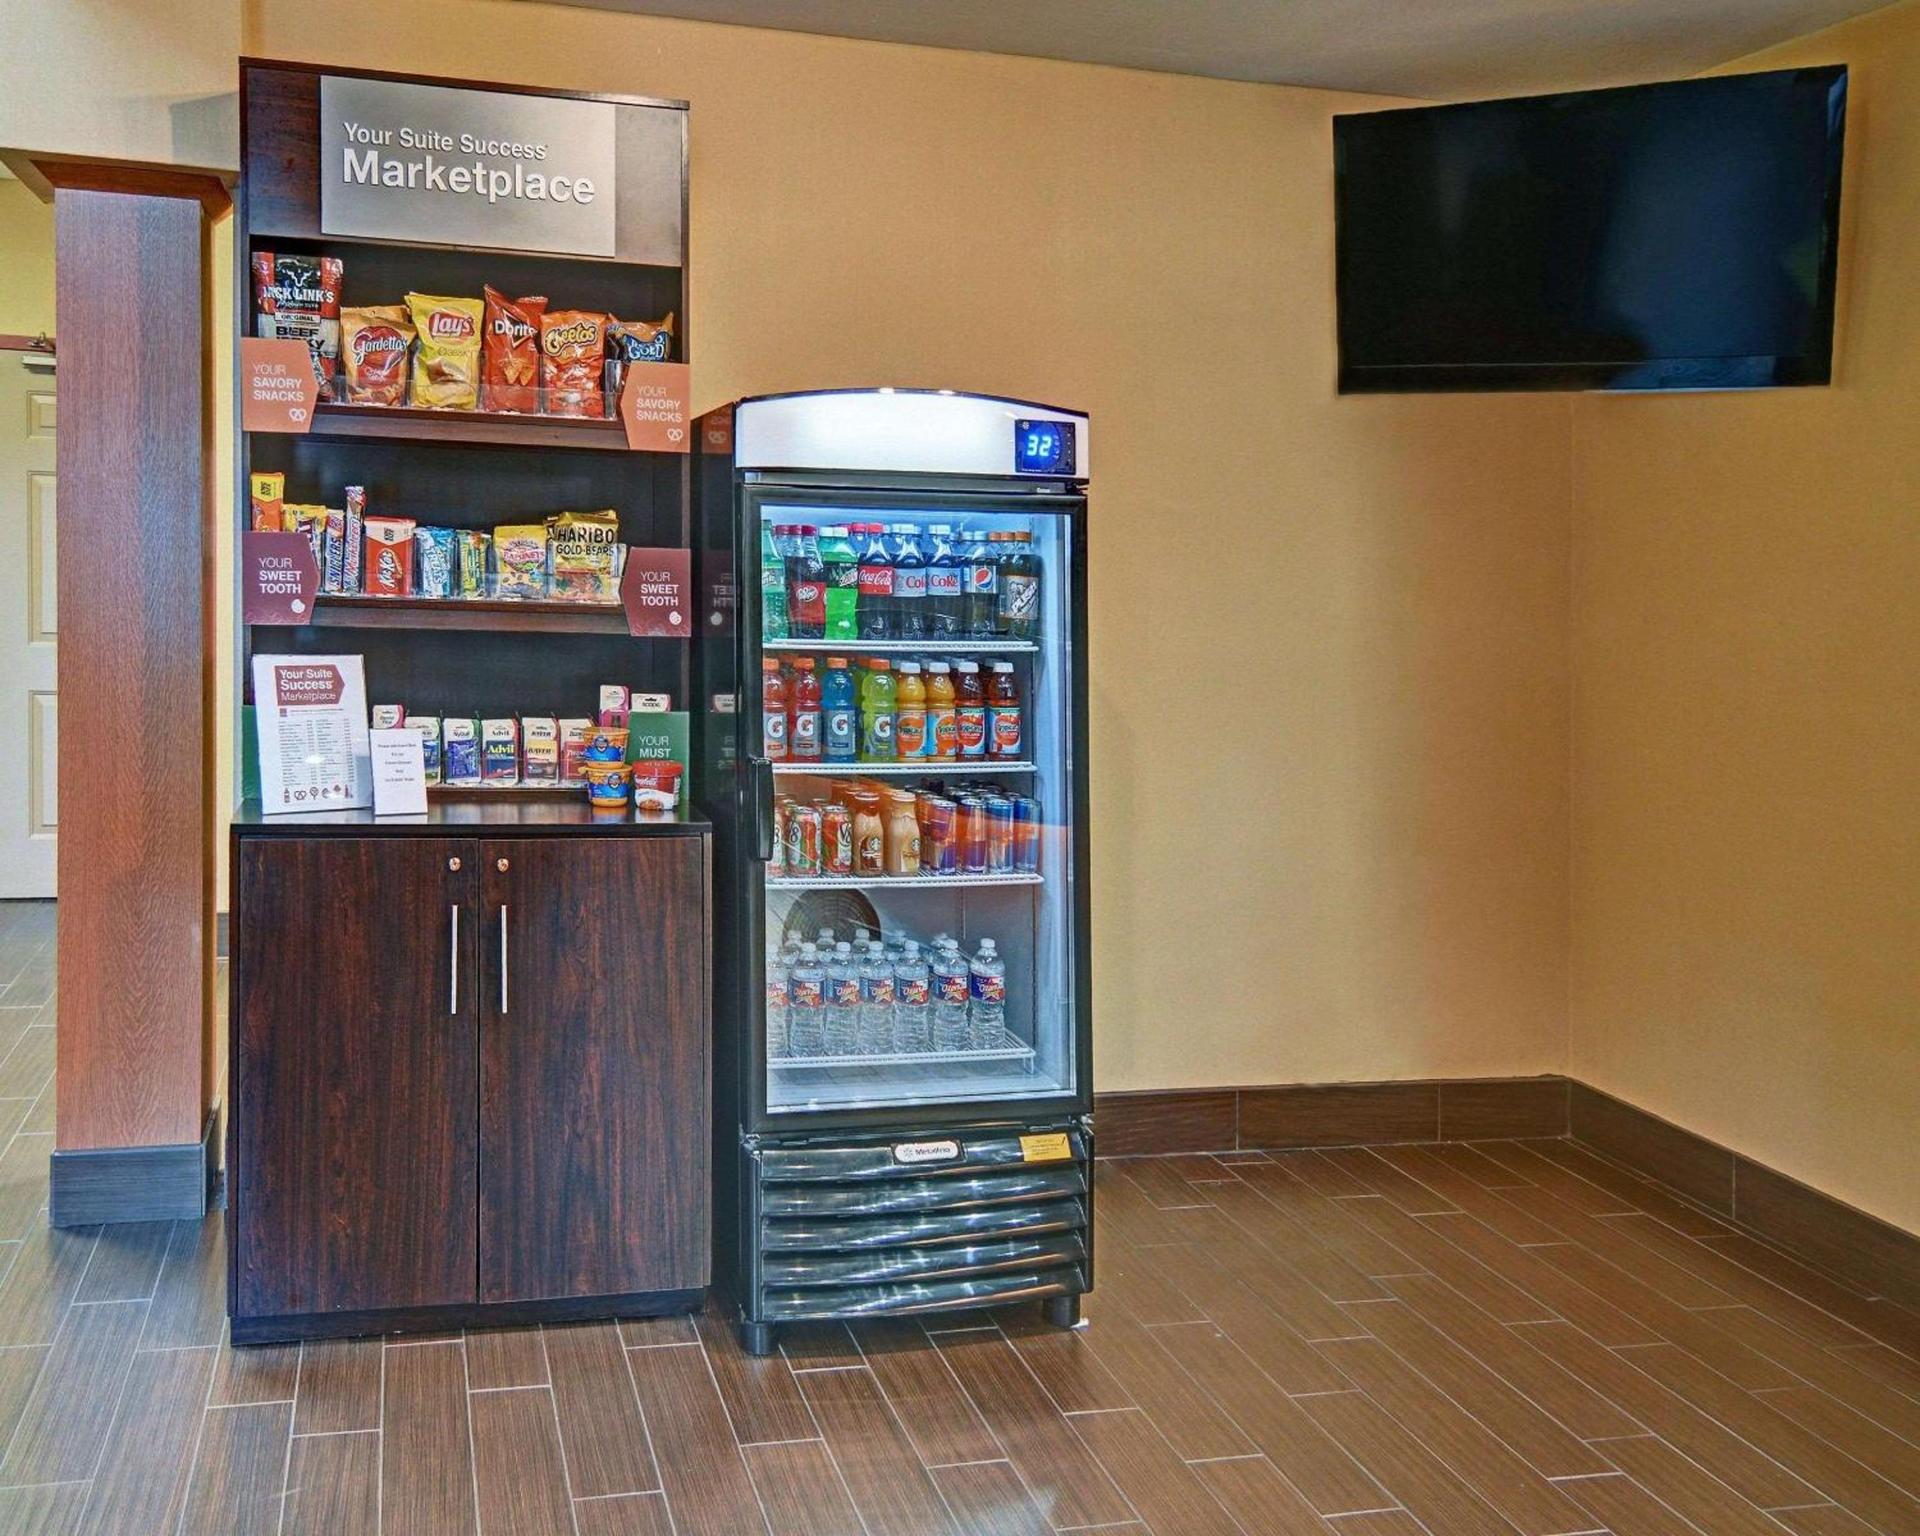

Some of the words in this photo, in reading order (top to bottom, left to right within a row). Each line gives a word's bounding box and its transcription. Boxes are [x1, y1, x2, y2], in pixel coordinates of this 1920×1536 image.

[343, 122, 393, 146] Your
[399, 128, 453, 152] Suite
[460, 134, 548, 161] Success
[343, 147, 596, 204] Marketplace
[292, 286, 334, 304] LINK'S
[276, 326, 319, 337] BEEF
[545, 322, 597, 356] Cheetos
[253, 364, 287, 375] YOUR
[253, 377, 302, 388] SAVORY
[253, 390, 304, 402] SNACKS
[636, 385, 667, 396] YOUR
[636, 399, 681, 410] SAVORY
[636, 410, 682, 422] SNACKS
[1026, 434, 1052, 457] 32
[557, 528, 614, 544] HARIBO
[259, 557, 293, 568] YOUR
[259, 570, 302, 581] SWEET
[640, 572, 671, 582] YOUR
[259, 583, 302, 594] TOOTH
[640, 584, 679, 594] SWEET
[640, 596, 679, 606] TOOTH
[280, 669, 304, 679] Your
[306, 669, 333, 679] Suite
[281, 680, 333, 691] Success
[281, 691, 336, 702] Marketplace
[639, 735, 669, 746] YOUR
[488, 744, 514, 754] Advil
[640, 748, 672, 758] MUST
